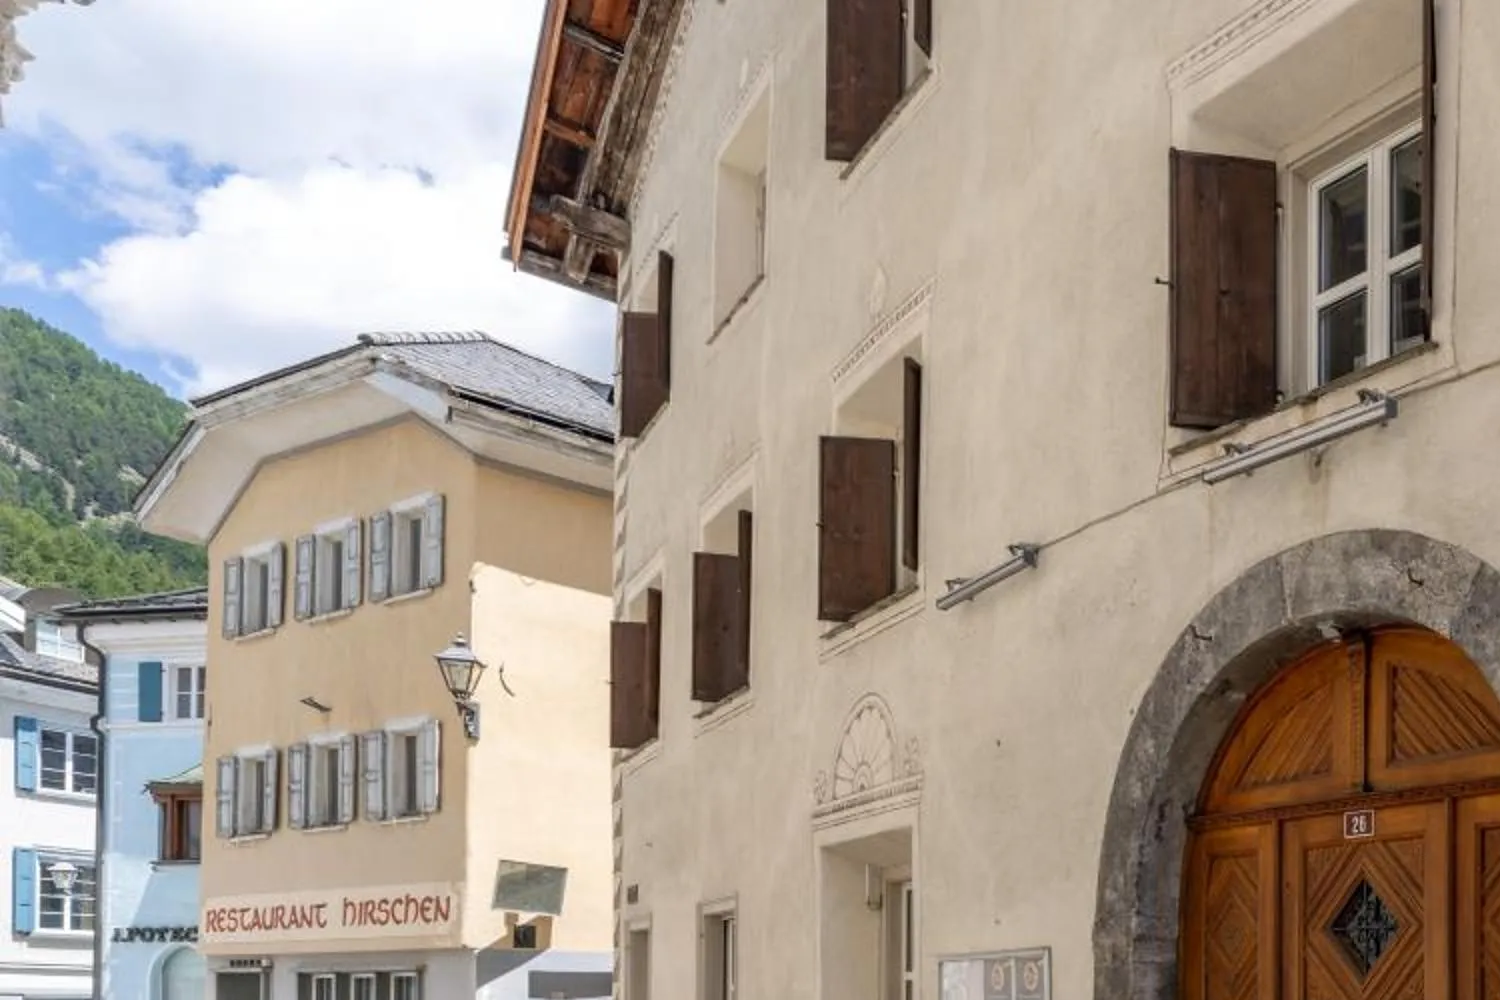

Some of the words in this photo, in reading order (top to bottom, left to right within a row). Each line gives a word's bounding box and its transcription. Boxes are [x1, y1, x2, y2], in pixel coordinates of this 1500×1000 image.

[1351, 815, 1367, 834] 26
[205, 903, 328, 933] RESTAURANT
[341, 894, 451, 926] HIRSCHEN
